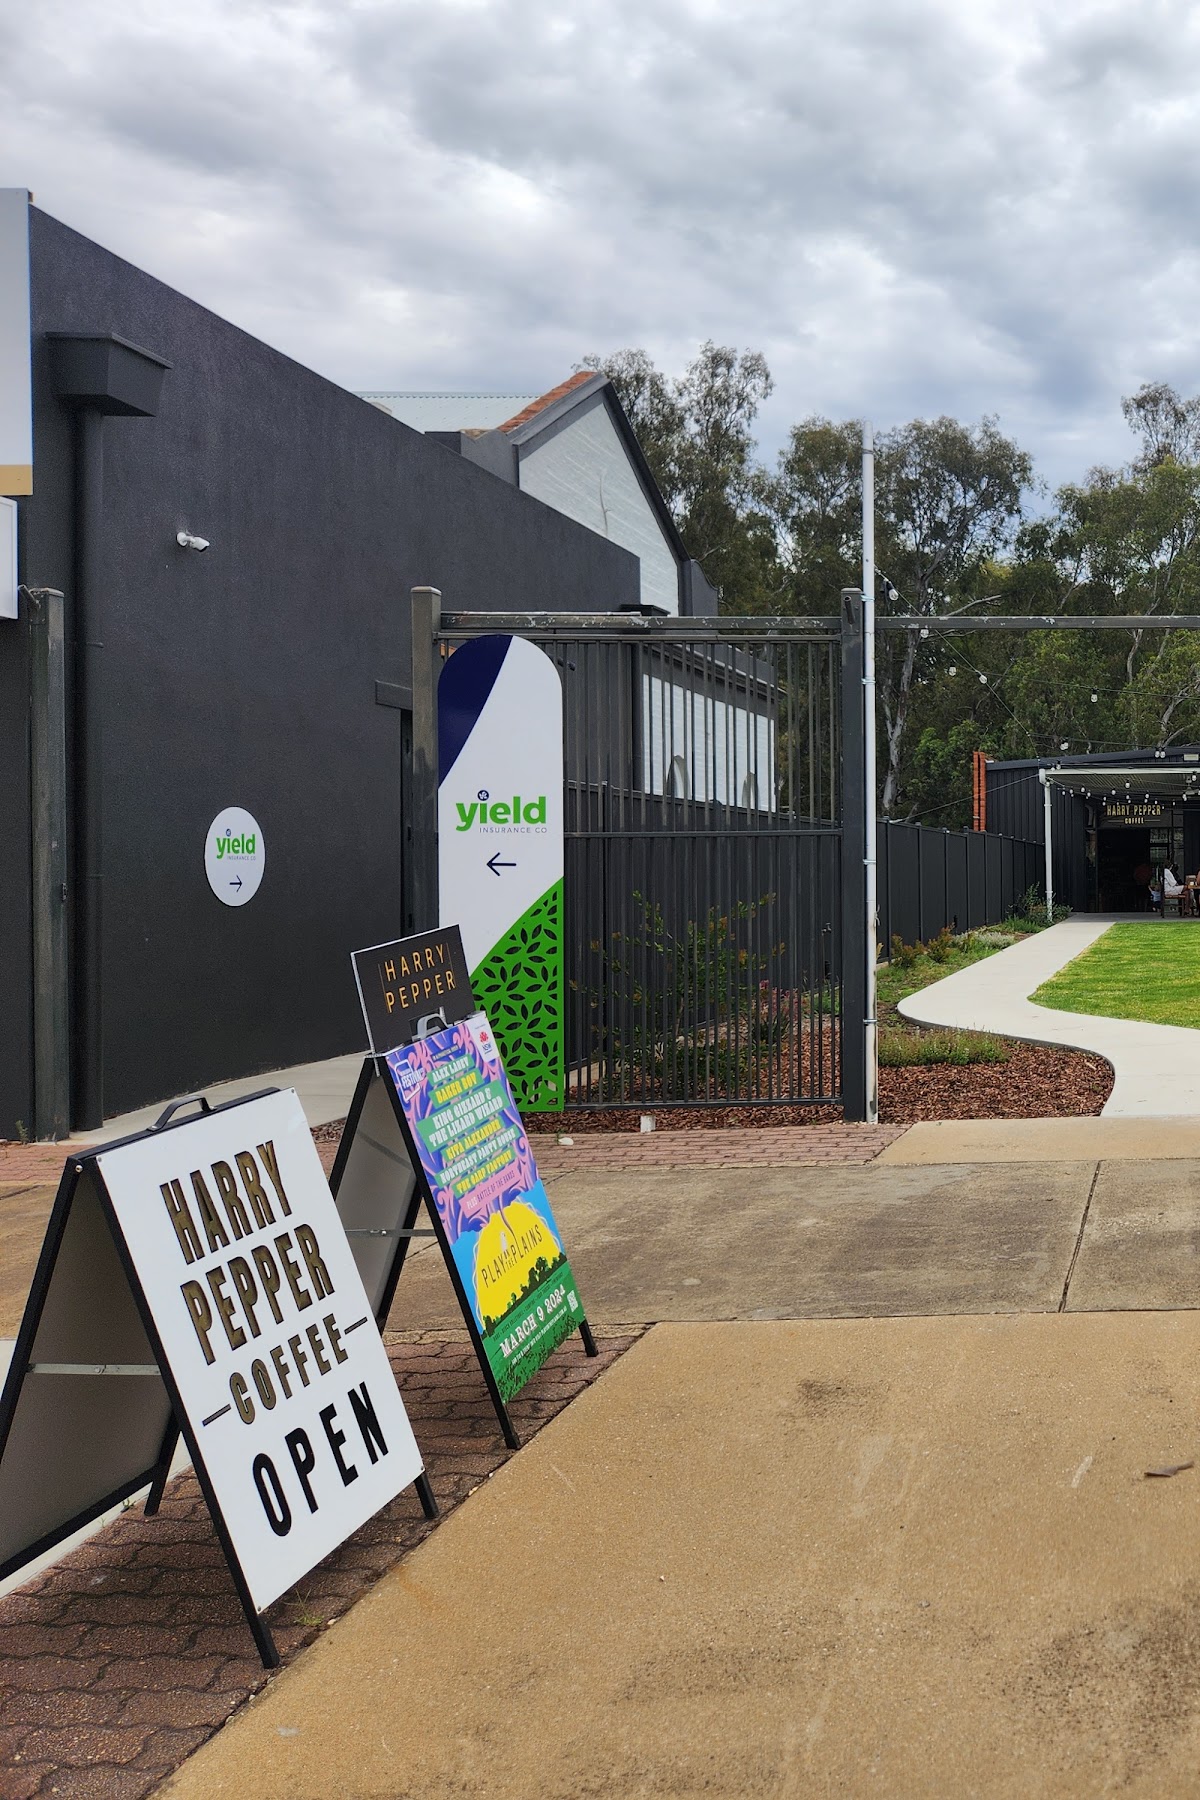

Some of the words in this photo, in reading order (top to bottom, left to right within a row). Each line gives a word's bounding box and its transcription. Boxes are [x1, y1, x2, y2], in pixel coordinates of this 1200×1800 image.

[456, 789, 546, 832] yield
[1107, 805, 1130, 816] HARRY
[1134, 805, 1161, 816] PEPPER
[216, 828, 256, 860] yield
[384, 943, 444, 982] HARRY
[385, 970, 456, 1014] PEPPER
[432, 1065, 451, 1084] ALEX
[434, 1081, 463, 1104] BAKER
[428, 1128, 449, 1147] THE
[432, 1108, 454, 1130] KING
[445, 1141, 465, 1160] KITA
[160, 1140, 293, 1266] HARRY
[510, 1224, 543, 1264] PLAINS
[481, 1253, 507, 1288] PLAY
[180, 1223, 336, 1366] PEPPER
[500, 1313, 538, 1358] MARCH
[536, 1306, 545, 1322] 9
[544, 1284, 567, 1315] 2024
[229, 1313, 350, 1425] COFFEE
[252, 1382, 389, 1538] OPEN
